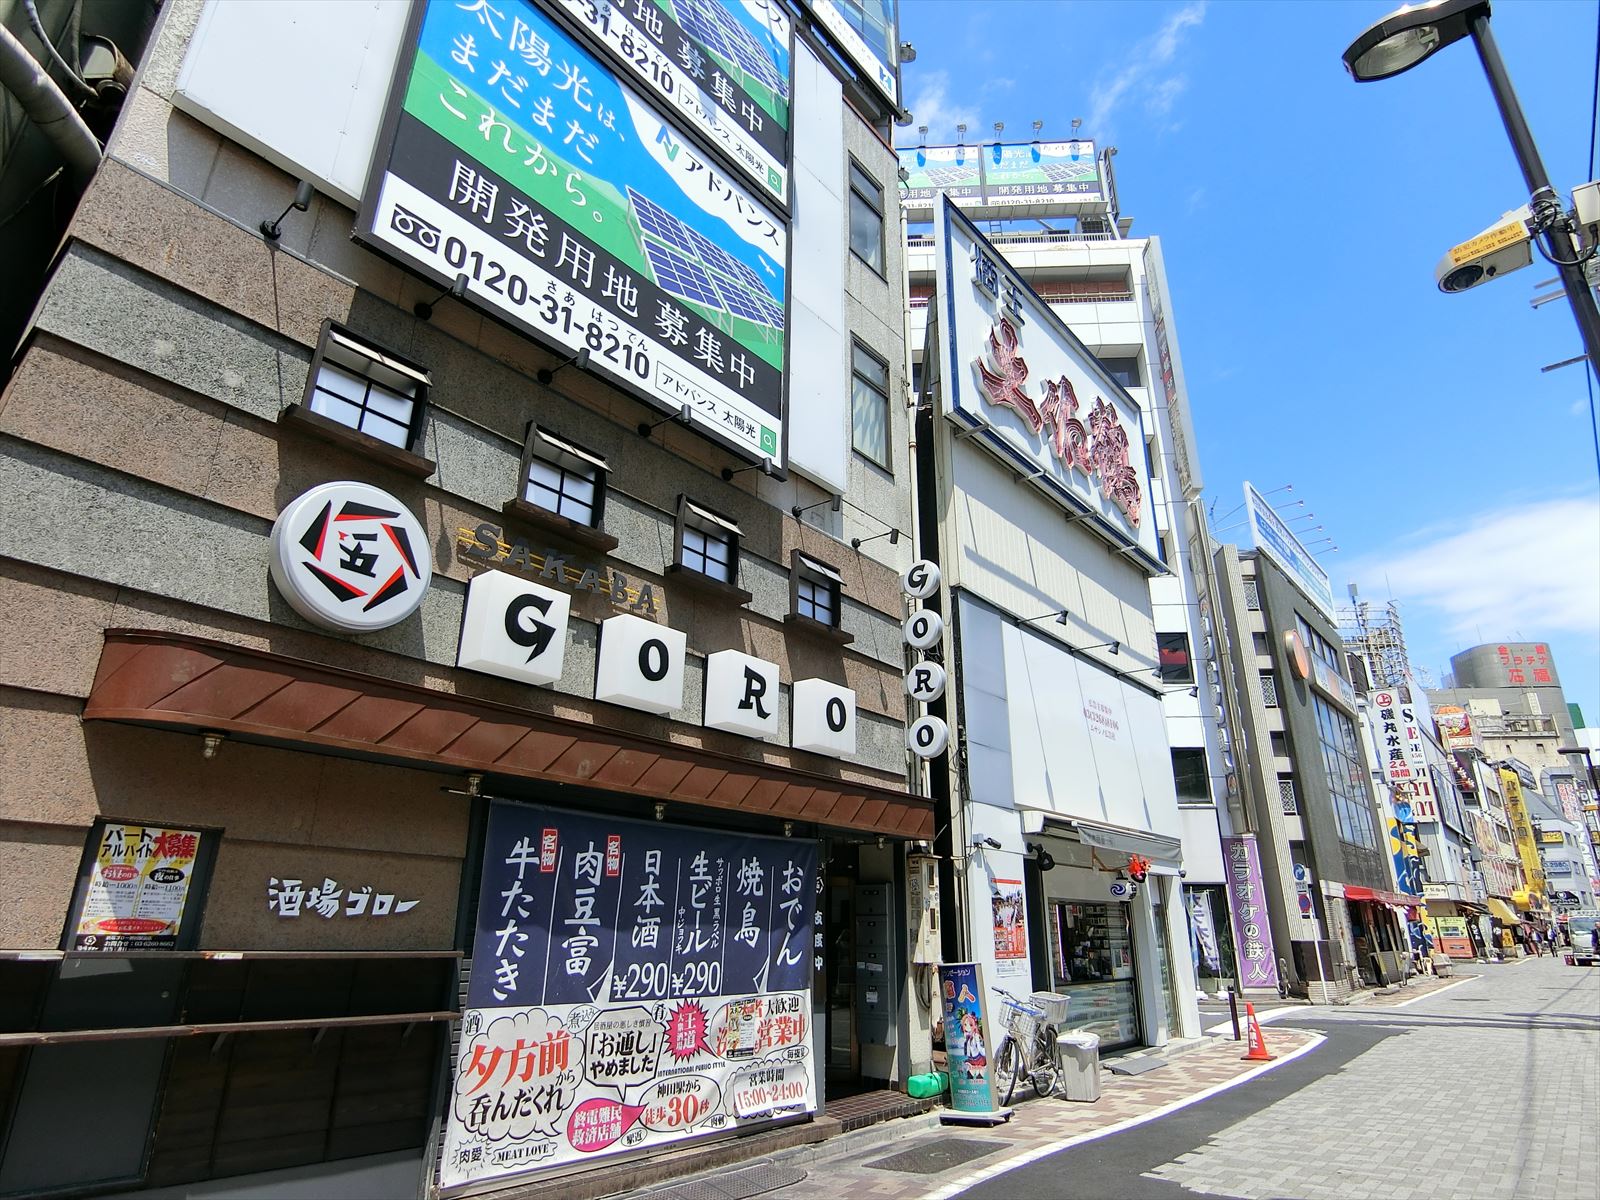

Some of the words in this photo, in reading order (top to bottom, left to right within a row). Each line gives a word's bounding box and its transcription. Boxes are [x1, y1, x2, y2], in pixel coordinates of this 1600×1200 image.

[451, 34, 600, 165] まだまだ
[676, 35, 763, 132] 募集中
[440, 79, 604, 223] これから。
[683, 94, 731, 145] アドバンス
[735, 140, 765, 176] 太陽光
[685, 150, 780, 247] アドバンス
[998, 184, 1049, 196] 開発用地
[1052, 182, 1089, 194] 募集中
[448, 159, 640, 319] 開発用地
[653, 298, 756, 389] 募集中
[547, 279, 576, 307] さあ
[443, 236, 651, 380] 0120-31-8210
[661, 372, 717, 416] アドバンス
[722, 409, 757, 440] 太陽光
[467, 523, 655, 613] SAKABA
[504, 593, 847, 733] GORO
[908, 564, 936, 747] GORO
[1380, 708, 1404, 761] 磯丸水産
[1389, 760, 1407, 769] 24
[1389, 768, 1411, 778] 時間
[101, 843, 153, 858] アルバイト
[105, 828, 153, 843] パート
[152, 831, 197, 859] 大募集
[542, 834, 556, 867] 名物
[607, 841, 620, 871] 名物
[268, 876, 421, 919] 酒場ゴロー
[493, 836, 540, 1001] 牛たたき
[561, 841, 605, 976] 肉豆富
[632, 849, 665, 949] 日本酒
[681, 850, 713, 955] 生ビール
[709, 856, 726, 949] サッポロ生黒ラベル
[734, 856, 765, 949] 焼鳥
[776, 860, 804, 967] おでん
[1230, 842, 1268, 981] カラオケの鉄人
[675, 905, 687, 955] 中ジョッキ
[612, 961, 668, 999] ¥290
[671, 960, 721, 996] ¥290
[568, 1008, 596, 1030] 煮込み
[684, 1010, 697, 1050] 王道
[757, 1013, 806, 1048] 営業中
[465, 1029, 573, 1097] 夕方前
[589, 1030, 657, 1059] 「お通し」
[556, 1068, 577, 1088] から
[589, 1055, 654, 1080] やめました
[656, 1079, 701, 1098] 神田駅から
[749, 1067, 786, 1088] 営業時間
[469, 1083, 565, 1128] 呑んだくれ
[573, 1104, 623, 1128] 終電難民
[458, 1145, 483, 1165] 肉愛
[497, 1147, 526, 1162] MEAT
[525, 1142, 549, 1159] LOVE
[572, 1121, 622, 1146] 救済店舗
